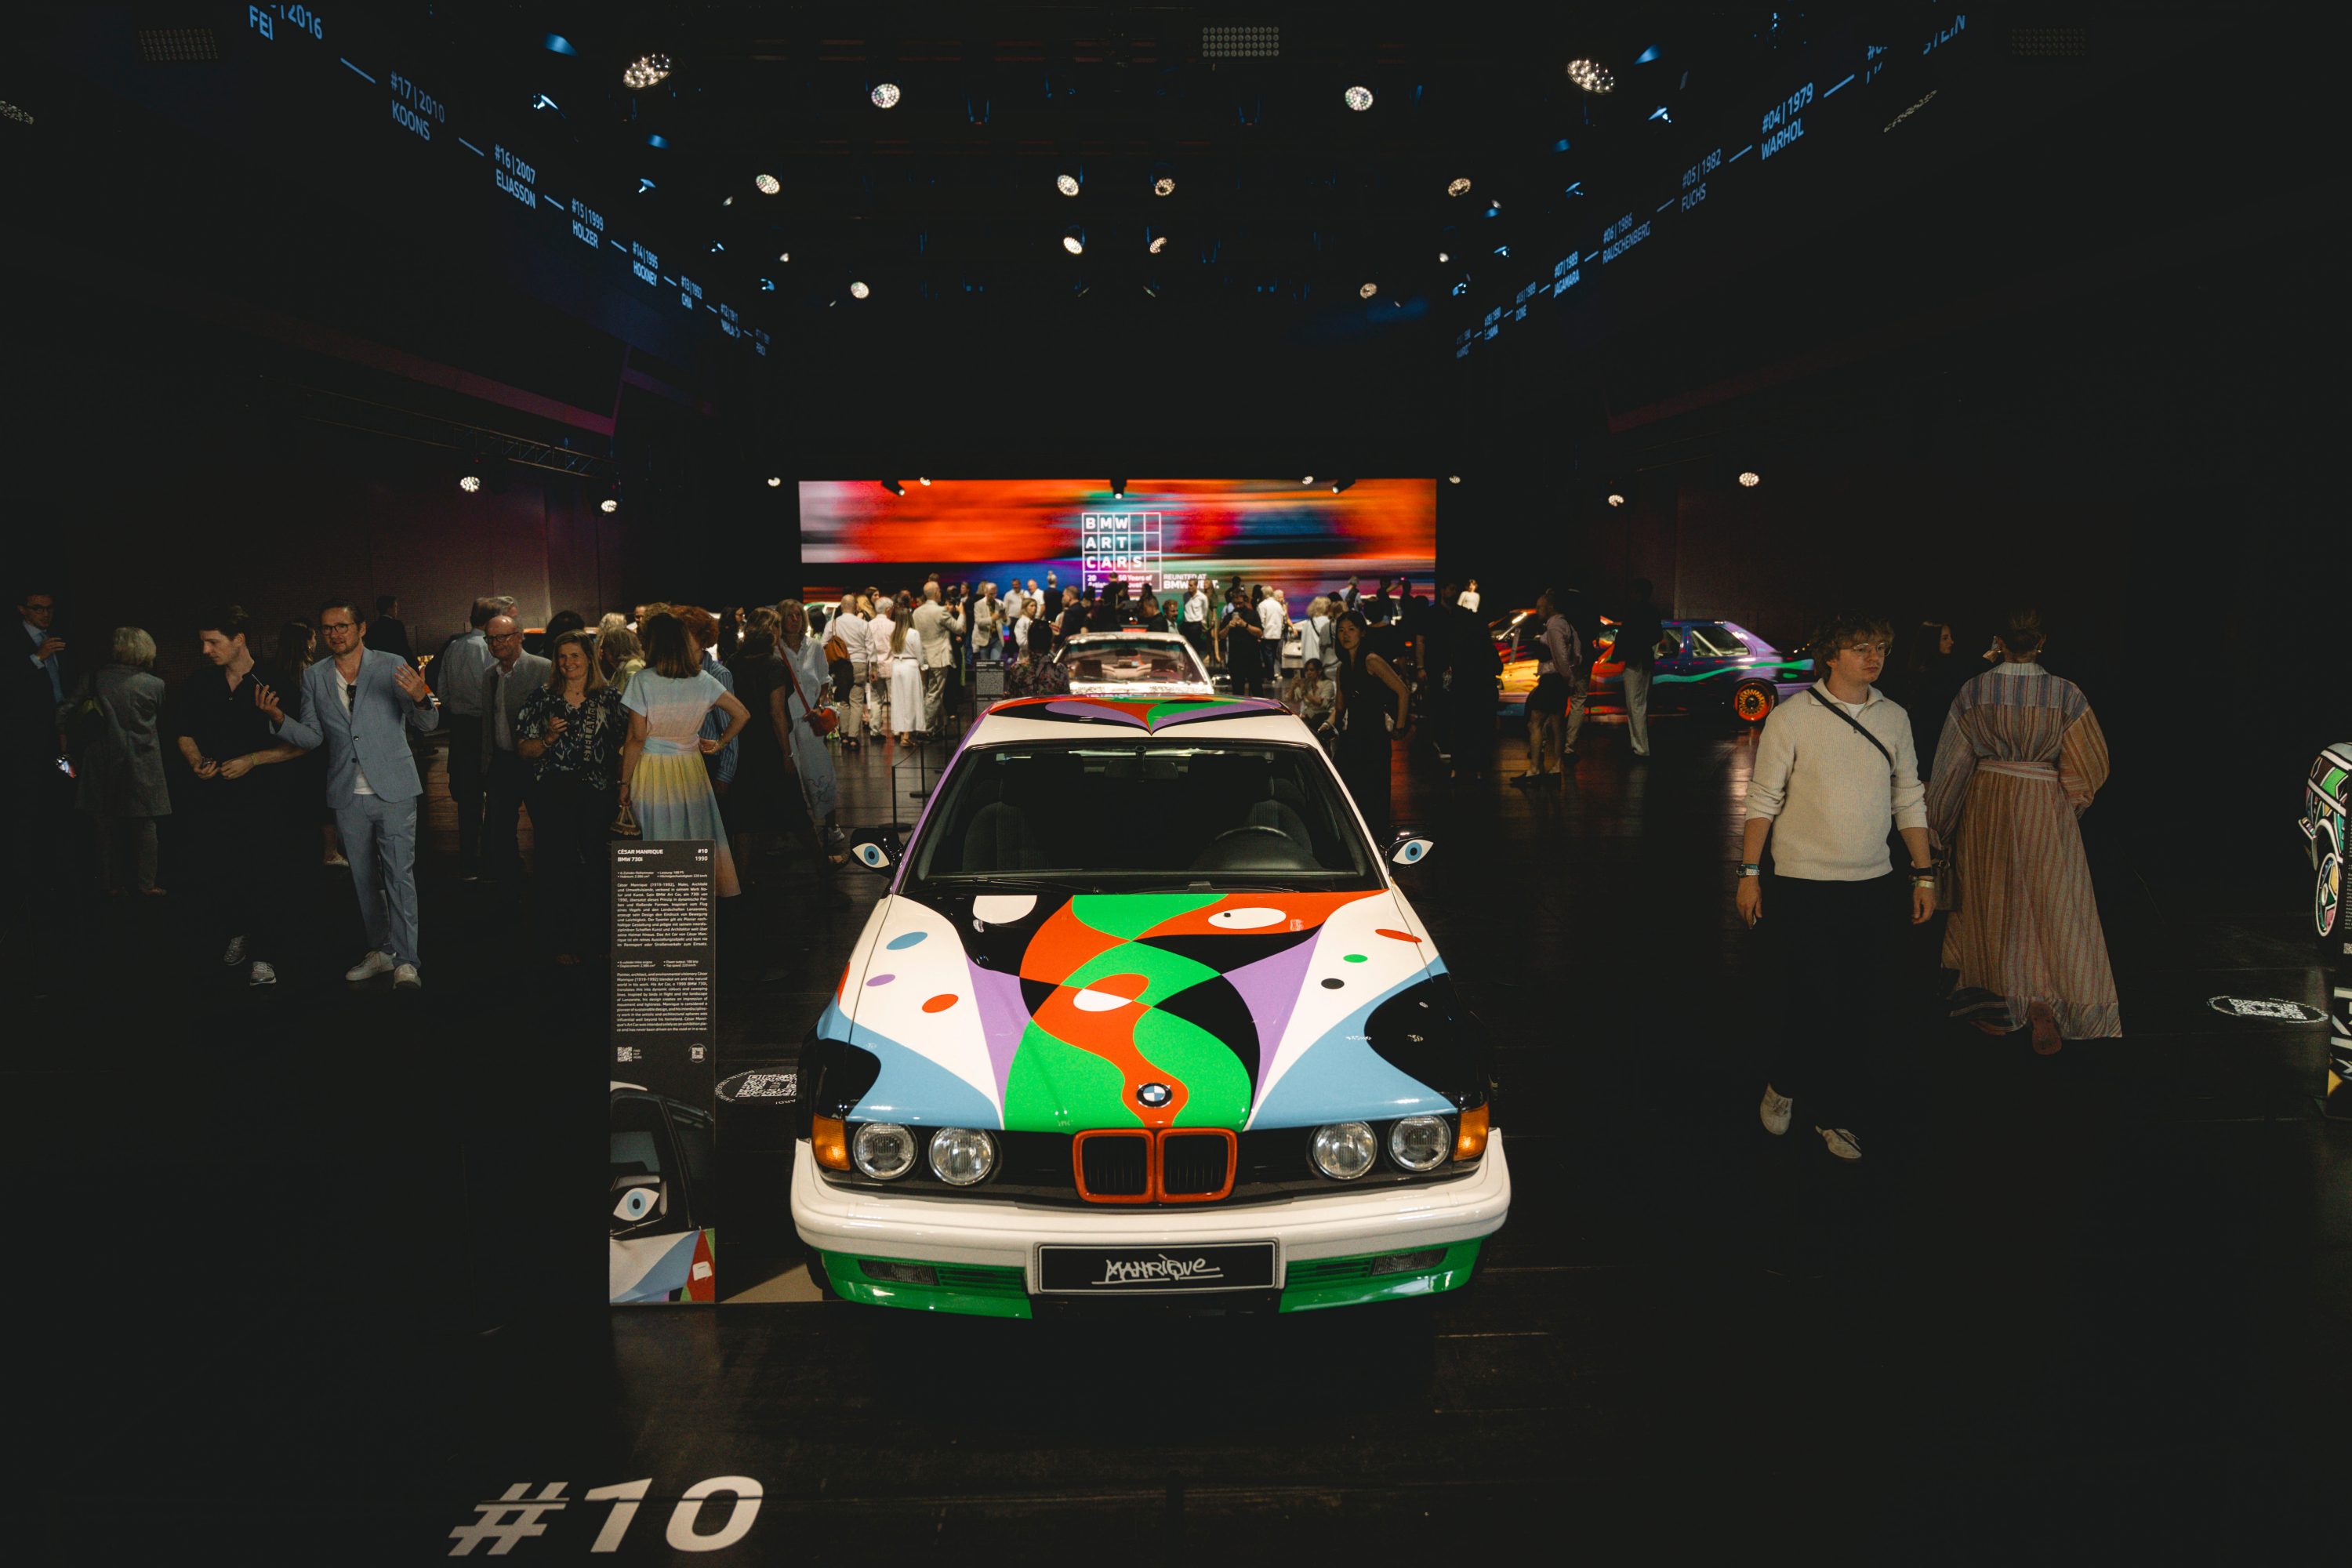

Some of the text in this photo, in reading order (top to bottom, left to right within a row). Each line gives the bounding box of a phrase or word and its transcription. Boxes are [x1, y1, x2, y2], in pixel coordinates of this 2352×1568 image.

[392, 100, 430, 140] KOONS
[1762, 118, 1804, 160] WARHOL
[495, 169, 535, 209] ELIASSON
[1682, 183, 1706, 213] FUCHS
[572, 220, 598, 249] HOLZER
[1602, 220, 1650, 264] RAUSCHENBERG
[633, 260, 657, 287] HOCKNEY
[1553, 269, 1580, 298] JAGAMARA
[1085, 517, 1129, 529] BMW
[1085, 537, 1127, 549] ART
[1086, 556, 1142, 569] CARS
[1163, 580, 1189, 589] BMW
[448, 1475, 764, 1556] #10
